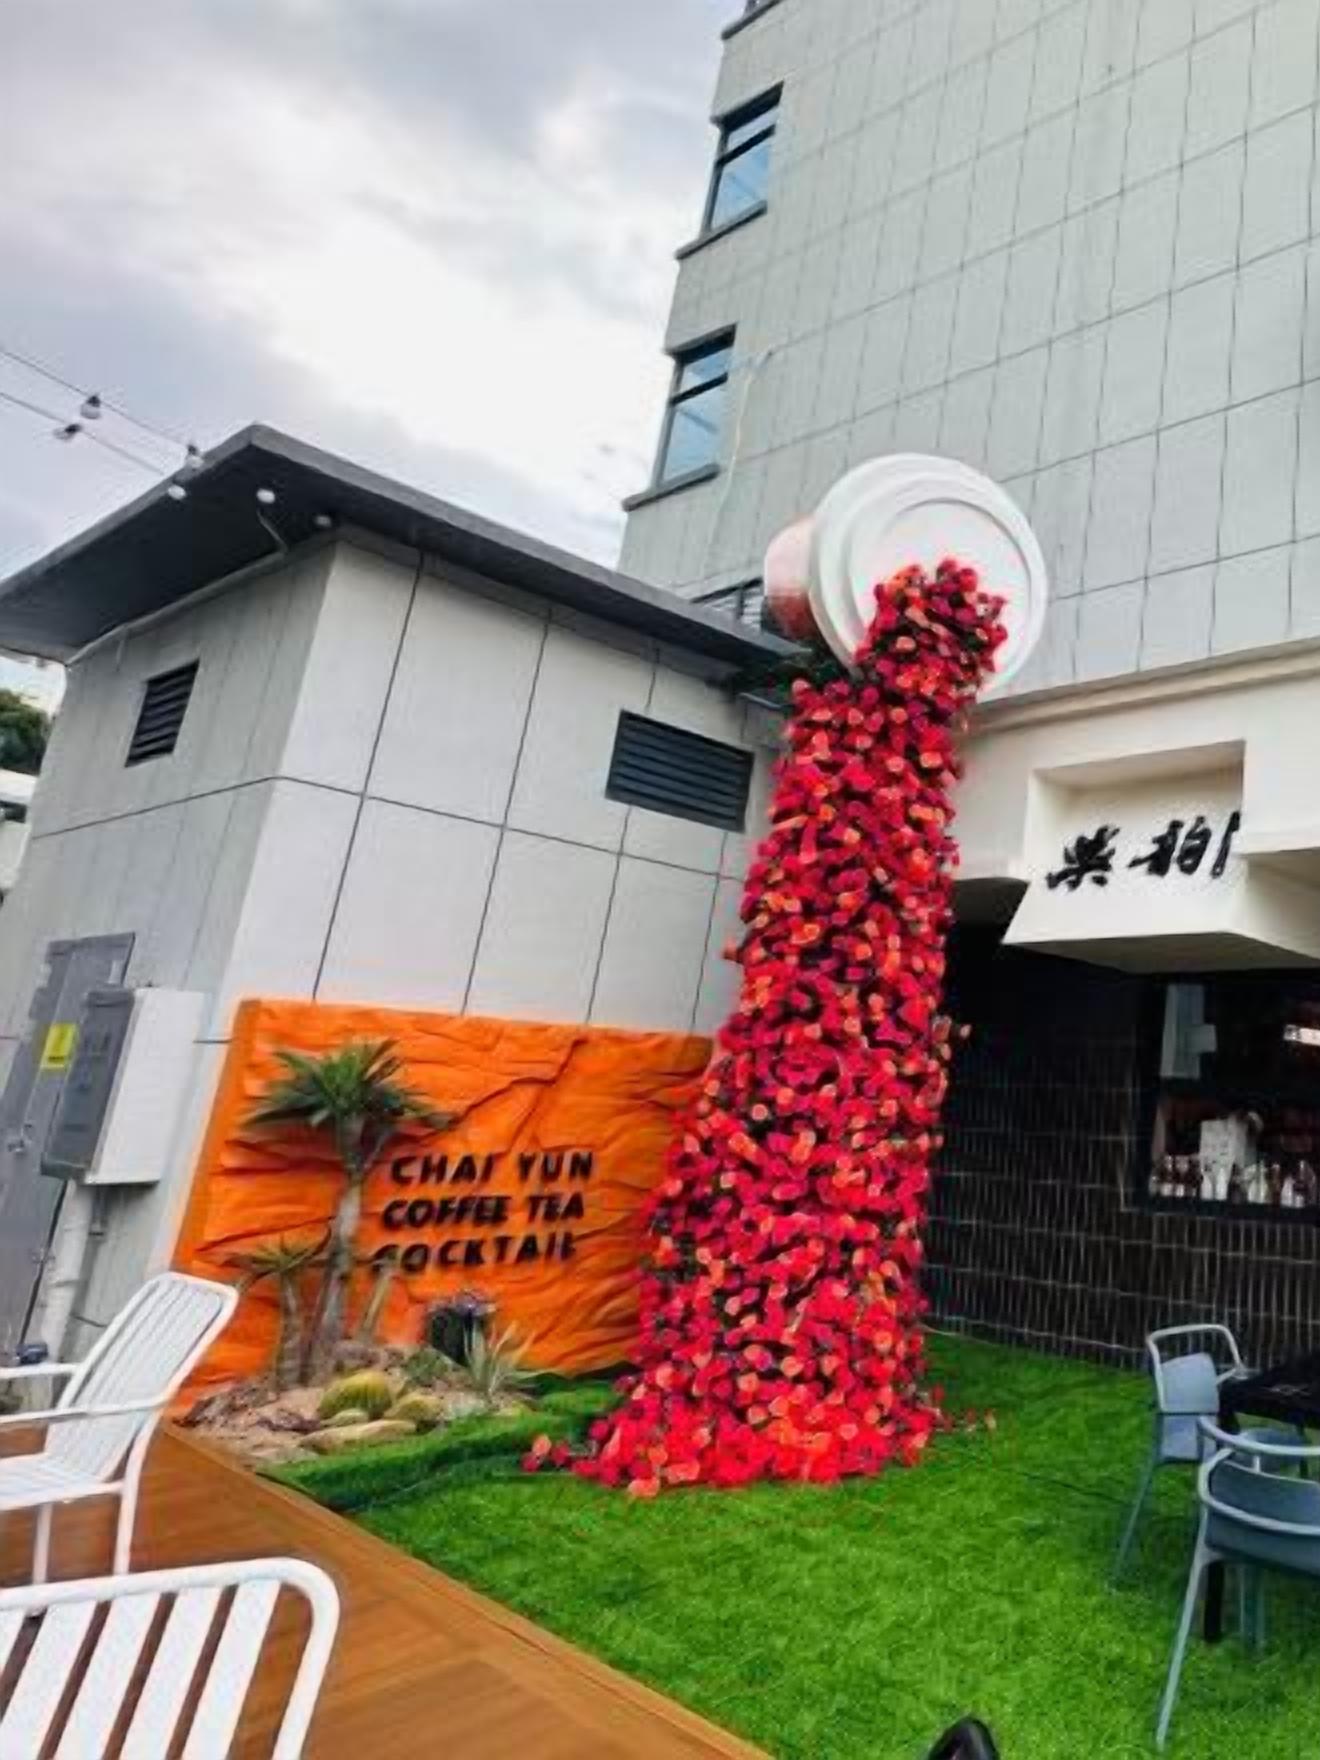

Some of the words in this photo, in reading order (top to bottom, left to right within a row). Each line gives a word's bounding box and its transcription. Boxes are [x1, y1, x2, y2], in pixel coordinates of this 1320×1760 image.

[391, 1153, 494, 1185] CHAI
[519, 1151, 593, 1182] YUN
[382, 1195, 511, 1230] COFFEE
[528, 1192, 584, 1223] TEA
